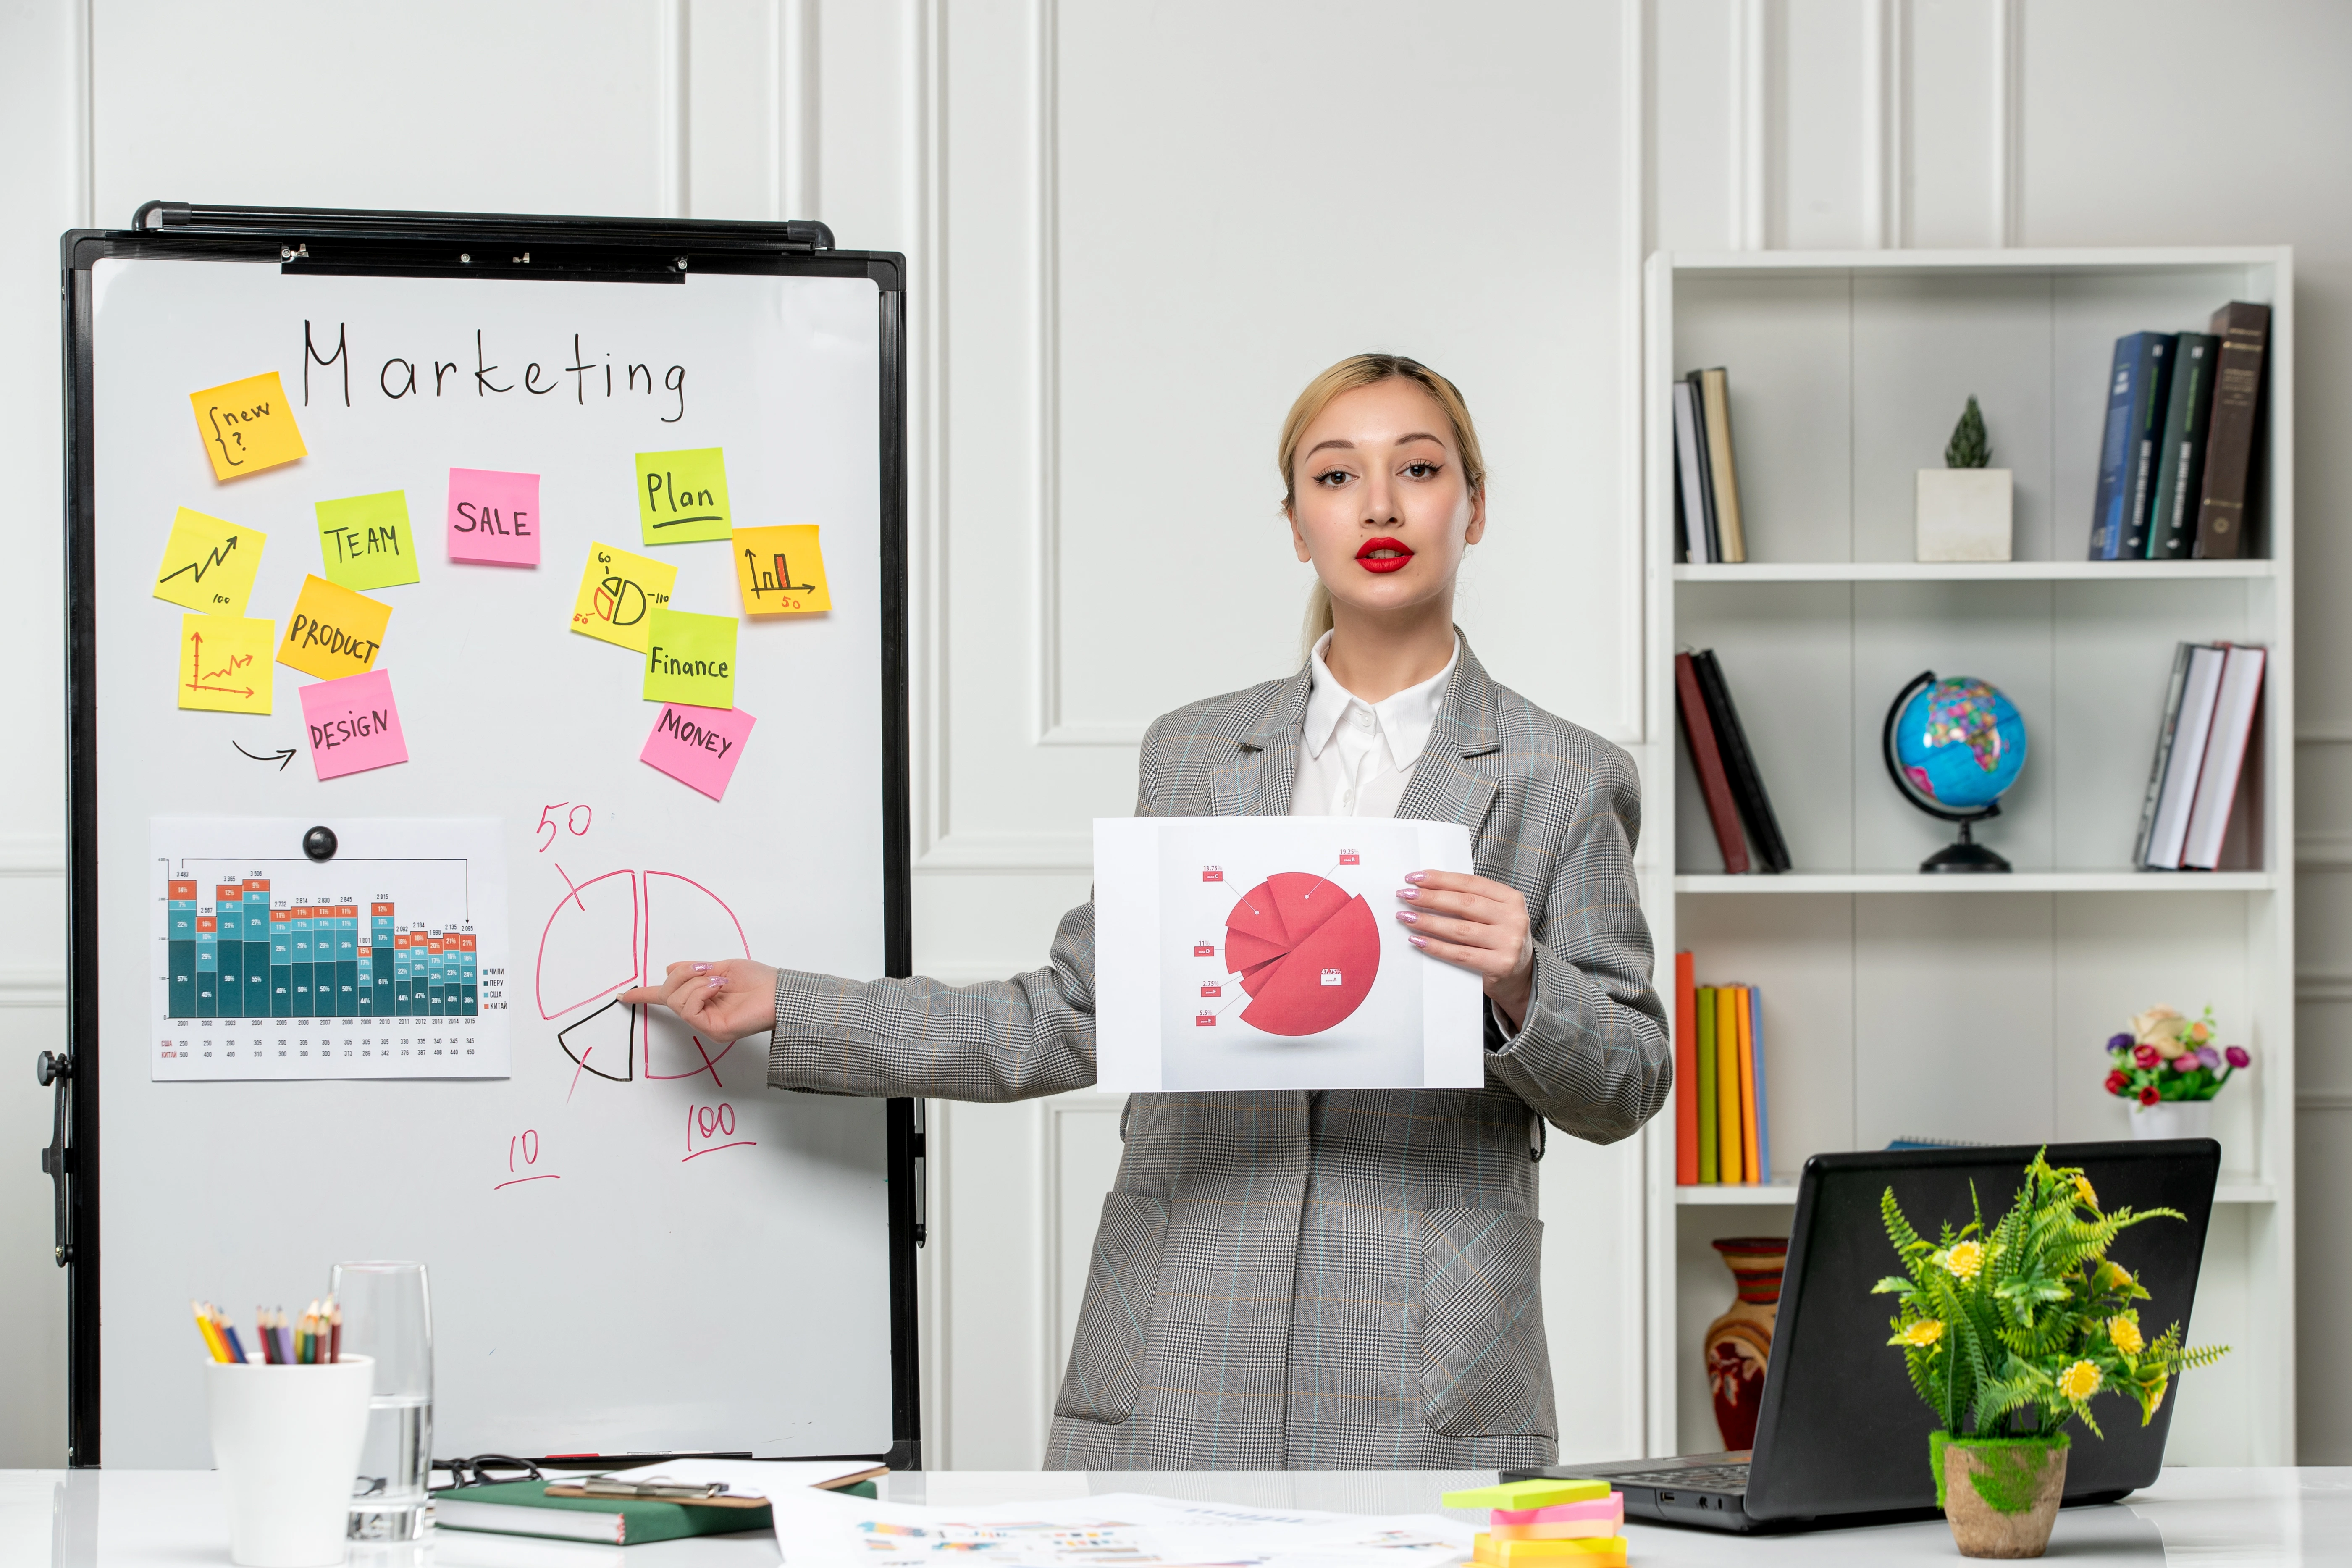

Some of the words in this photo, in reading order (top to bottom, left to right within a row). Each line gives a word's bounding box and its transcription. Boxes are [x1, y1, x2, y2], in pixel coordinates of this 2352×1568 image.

[304, 319, 685, 423] Marketing
[223, 402, 270, 426] new
[232, 432, 246, 451] ?
[647, 472, 714, 512] Plan
[454, 502, 531, 536] SALE
[324, 525, 399, 563] TEAM
[598, 552, 611, 563] 60
[213, 594, 230, 604] 100
[656, 593, 669, 604] 110
[782, 596, 800, 609] 50
[573, 614, 589, 625] 50
[290, 613, 380, 664] PRODUCT
[651, 646, 728, 678] Finance
[310, 709, 387, 750] DESIGN
[658, 708, 732, 759] MONEY
[536, 802, 591, 852] 50
[686, 1103, 736, 1152] 100
[510, 1130, 538, 1172] 10
